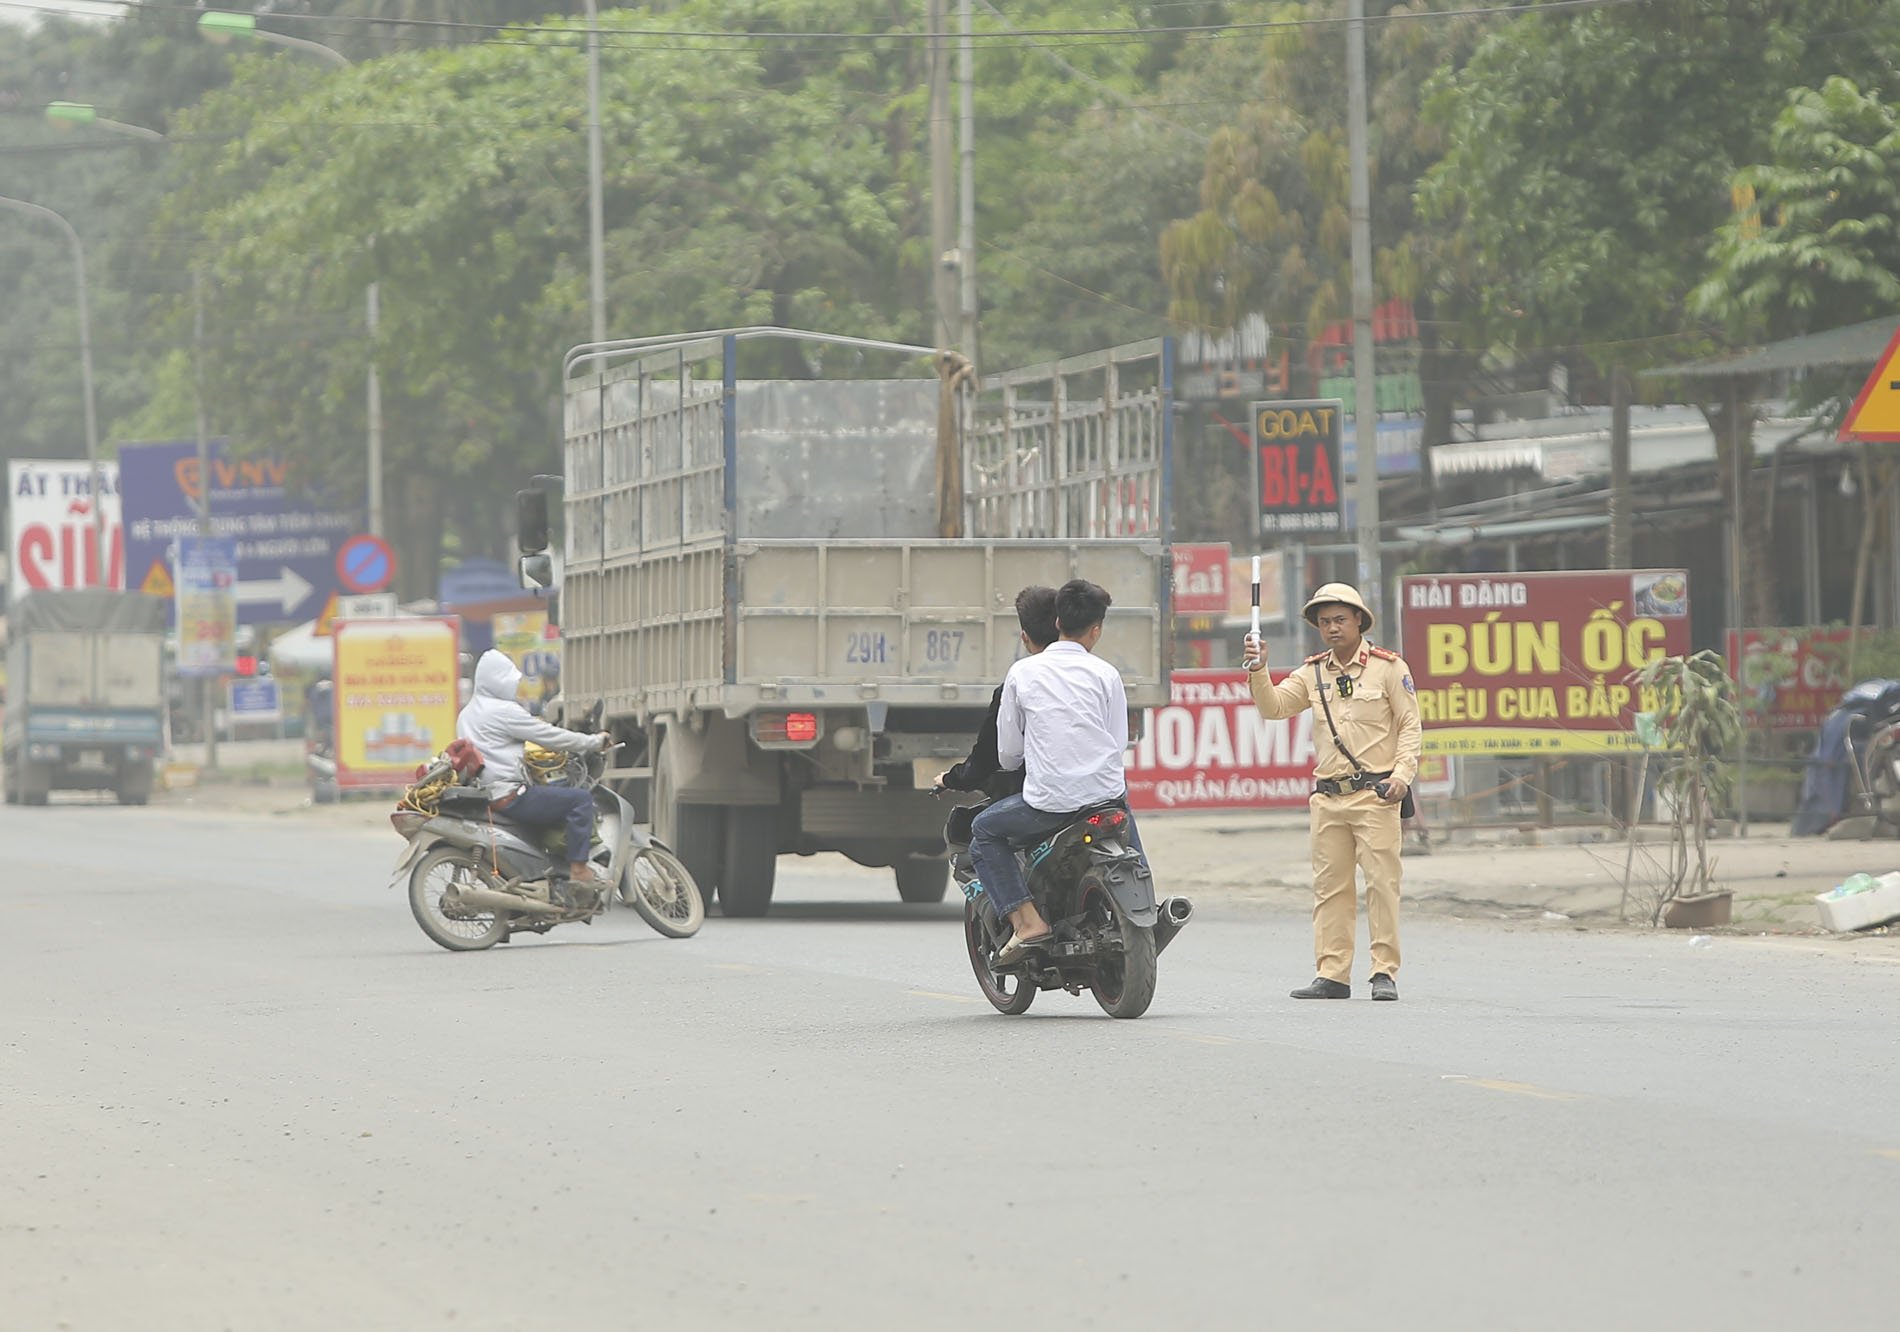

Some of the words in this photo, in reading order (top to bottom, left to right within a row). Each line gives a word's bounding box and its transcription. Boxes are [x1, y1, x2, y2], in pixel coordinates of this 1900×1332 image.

[1260, 408, 1334, 439] GOAT
[1410, 577, 1452, 607] HẢI
[1459, 578, 1528, 607] ĐĂNG
[1427, 611, 1561, 677] BÚN
[1581, 600, 1667, 673] ỐC
[1495, 686, 1559, 720] CUA
[1565, 677, 1631, 718] BẮP
[1259, 777, 1311, 800] NAM
